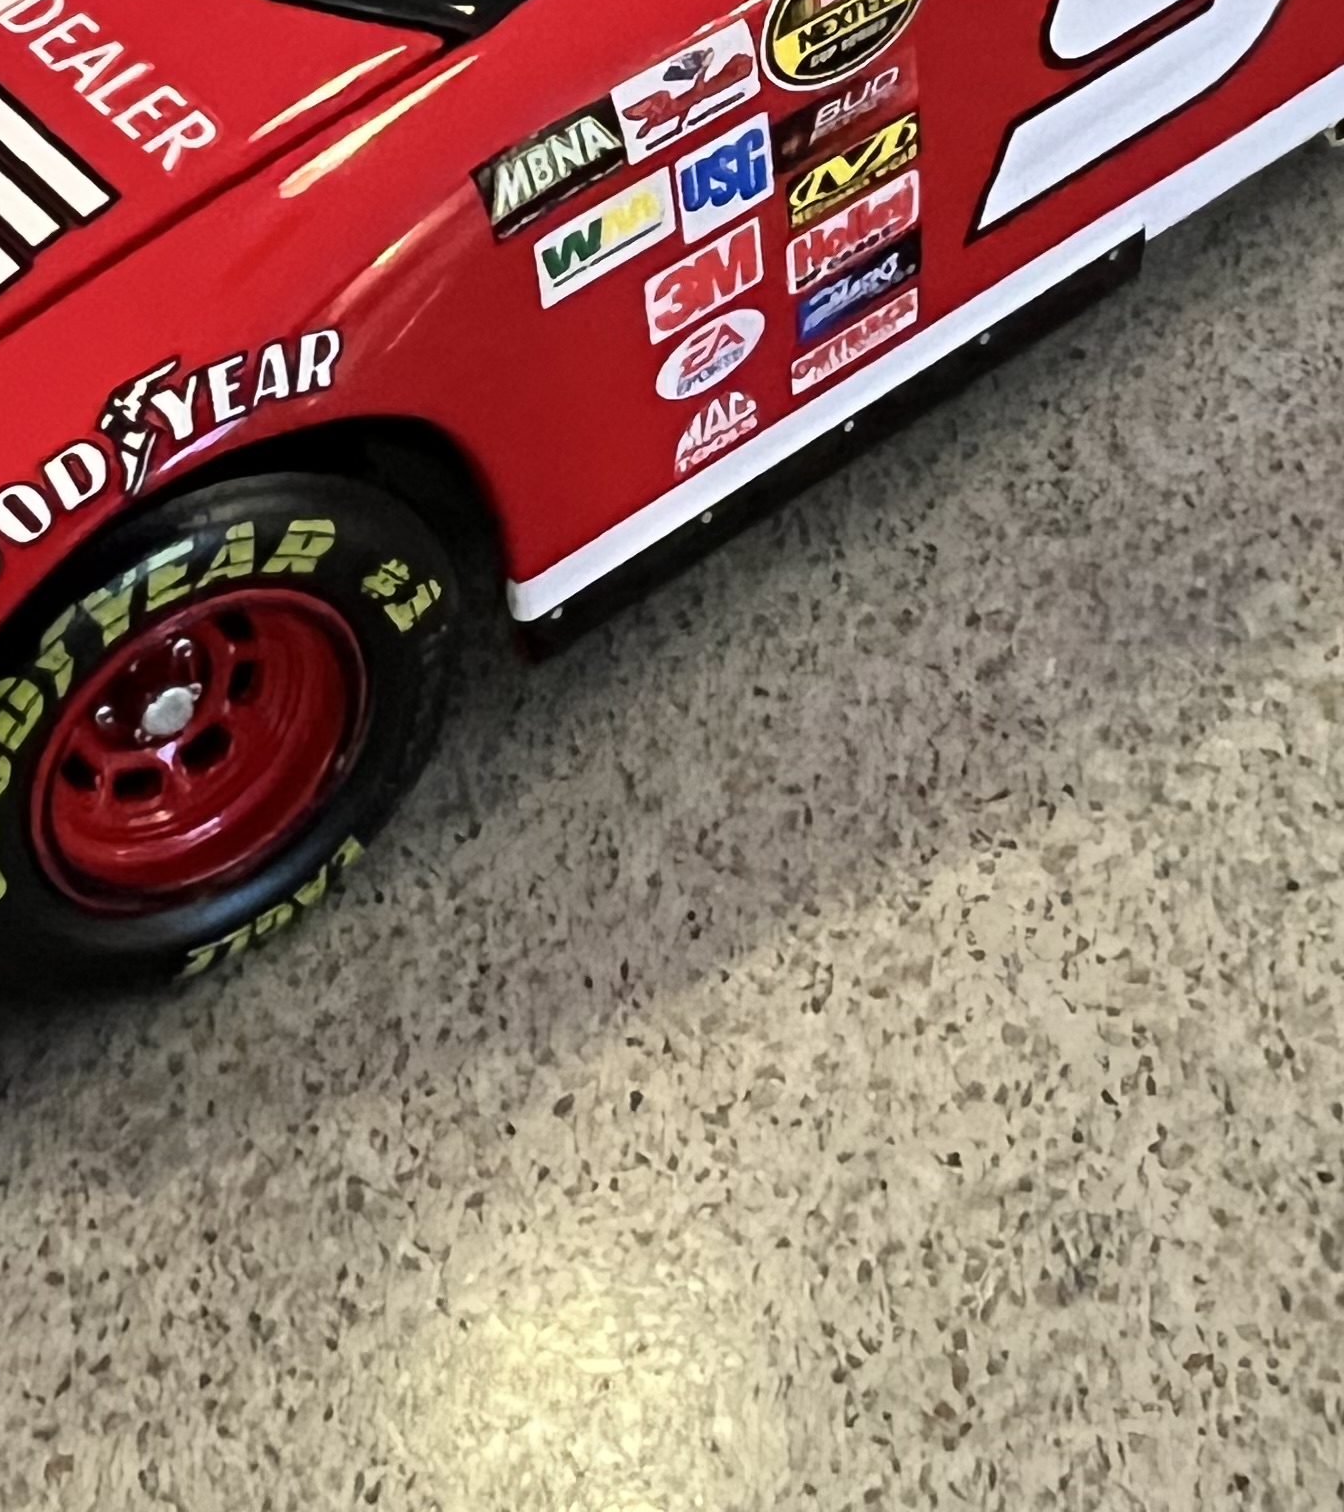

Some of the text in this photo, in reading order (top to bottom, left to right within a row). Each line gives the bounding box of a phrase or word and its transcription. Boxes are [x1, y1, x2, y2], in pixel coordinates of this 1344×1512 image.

[492, 115, 623, 226] MBNA
[681, 128, 767, 212] USG
[654, 224, 757, 331] 3M
[681, 322, 746, 378] EA
